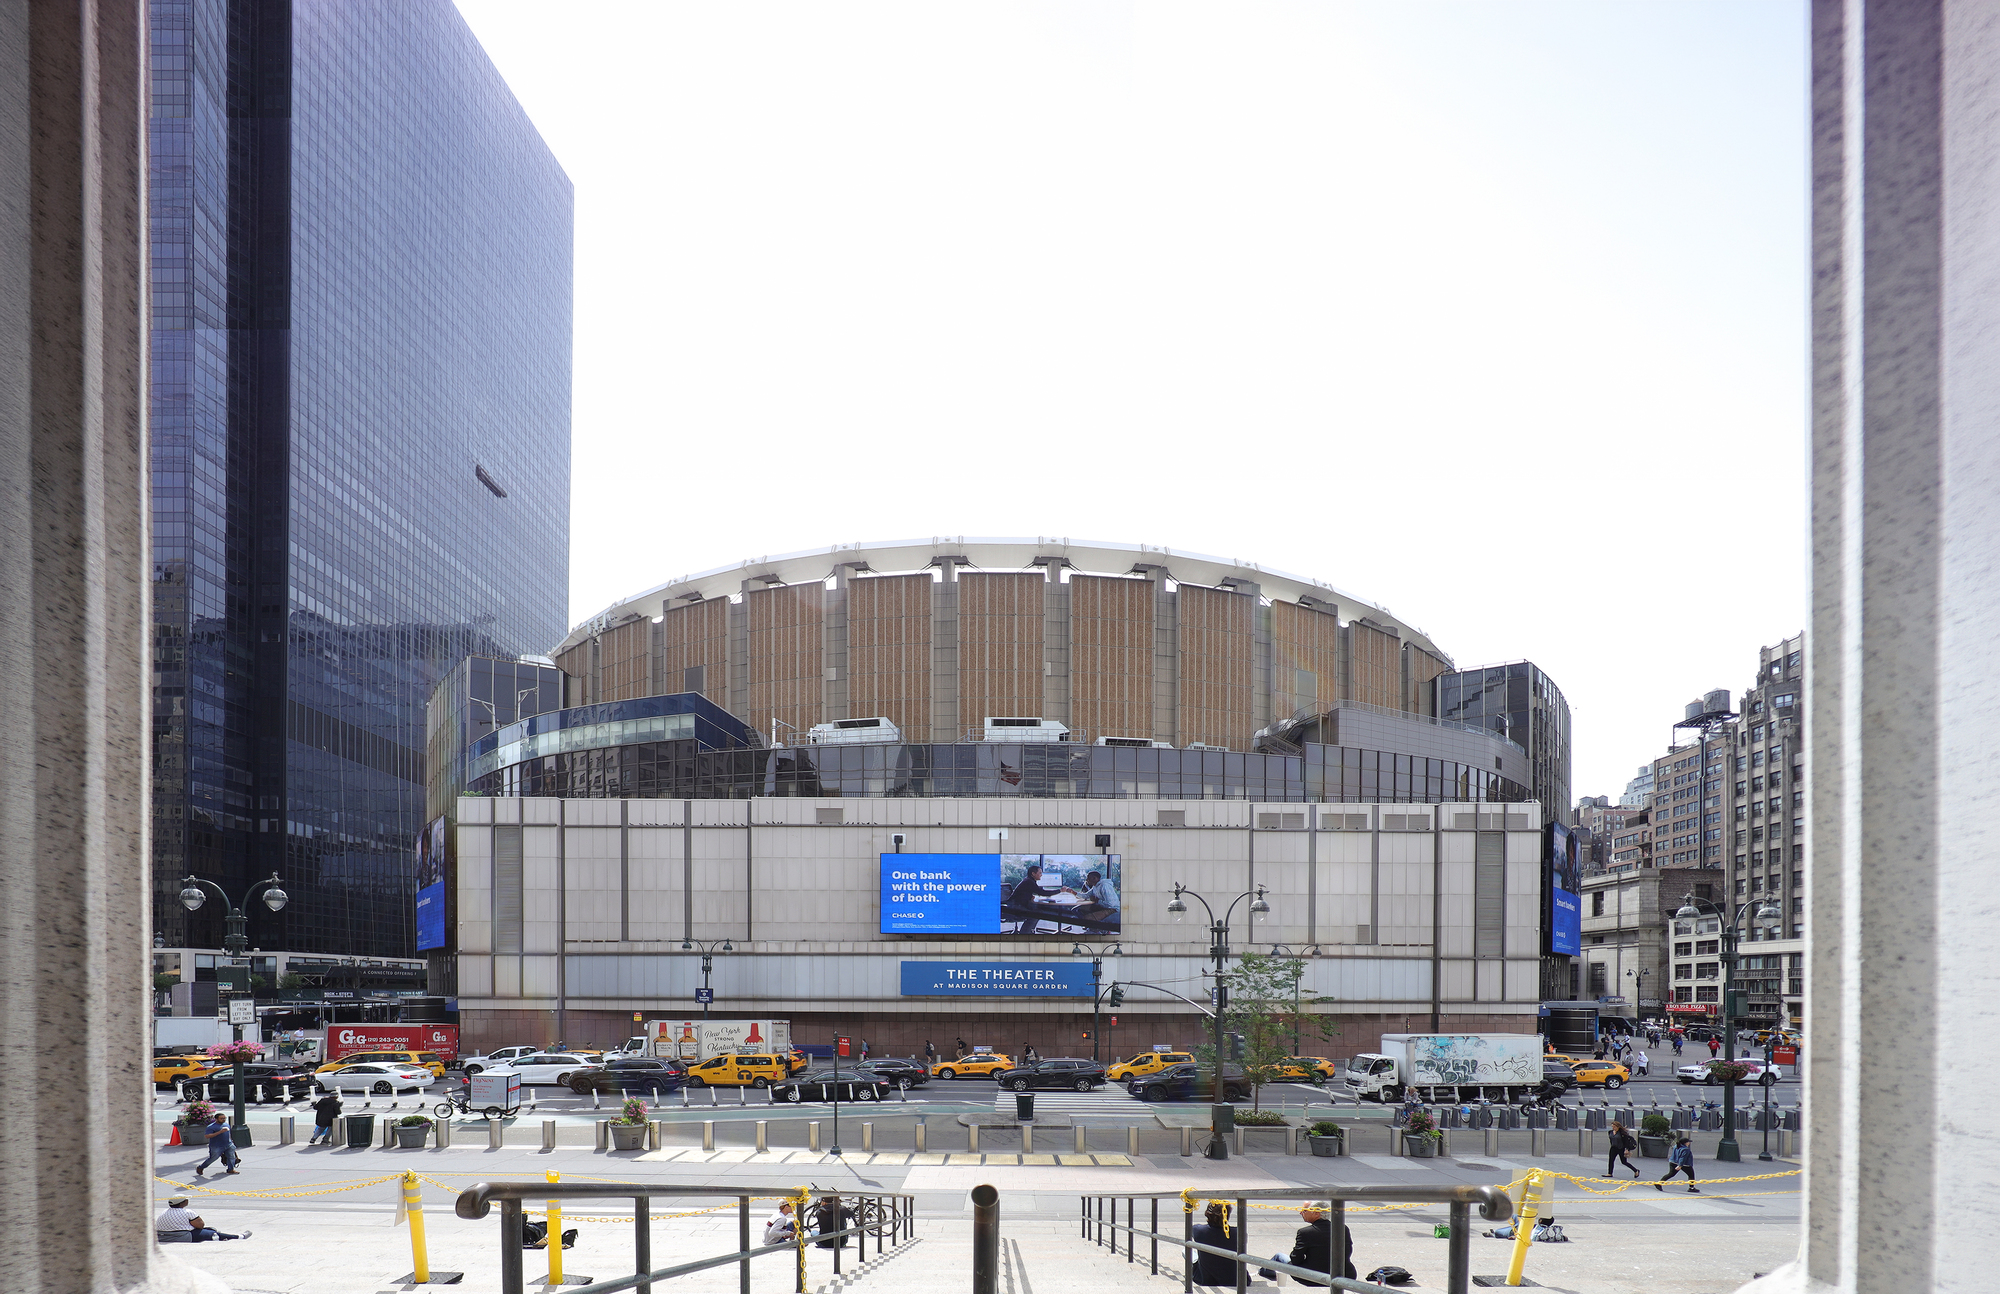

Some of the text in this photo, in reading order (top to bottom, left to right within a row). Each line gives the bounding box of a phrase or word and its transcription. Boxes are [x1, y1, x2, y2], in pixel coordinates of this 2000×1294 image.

[892, 870, 951, 880] One bank
[892, 881, 986, 893] with the power
[892, 892, 940, 902] of both.
[946, 969, 1055, 980] THE THEATER
[720, 1027, 741, 1036] York
